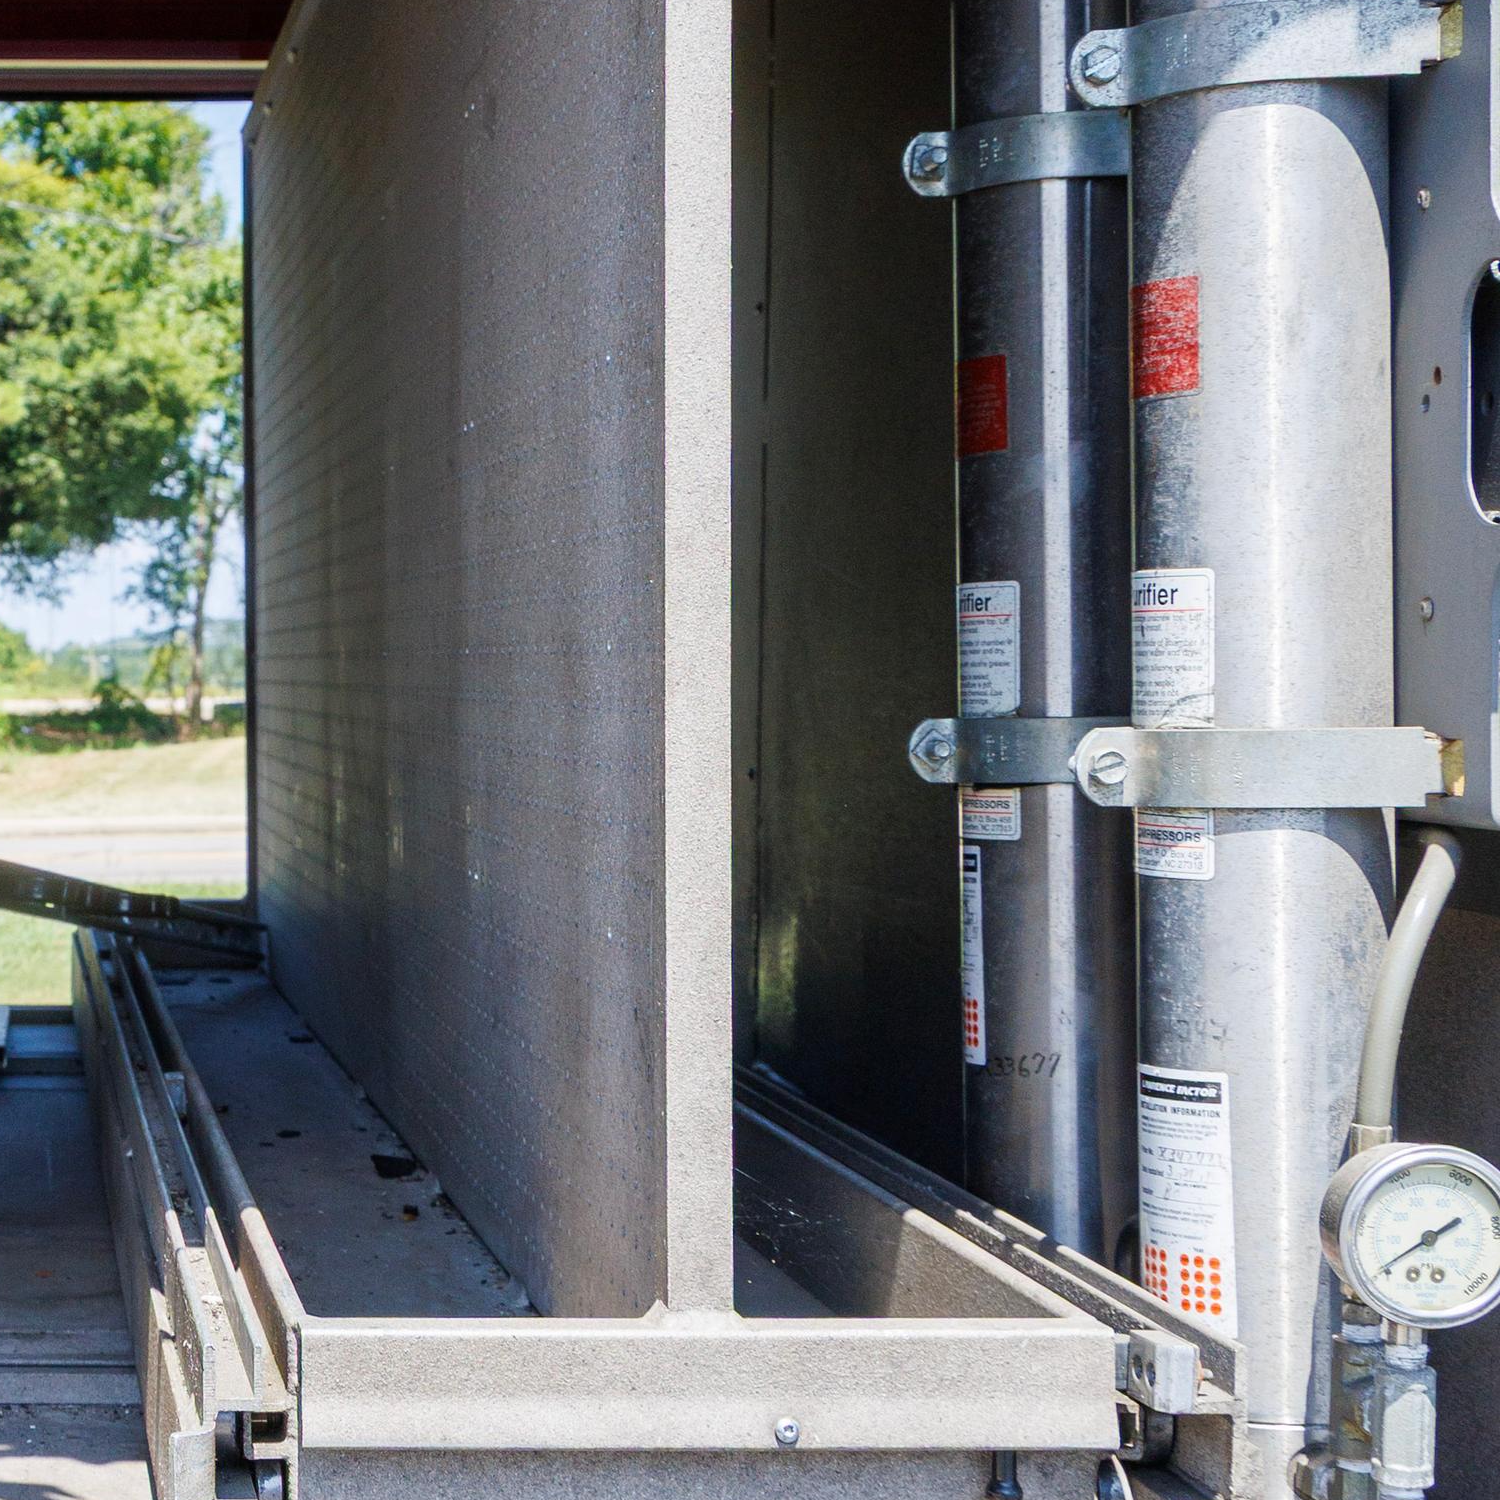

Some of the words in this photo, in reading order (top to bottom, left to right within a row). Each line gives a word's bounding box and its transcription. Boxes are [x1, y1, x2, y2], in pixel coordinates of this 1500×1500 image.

[1177, 1085, 1218, 1098] FACTOR
[1170, 1105, 1221, 1118] INFORMATION
[1463, 1273, 1490, 1297] 10000
